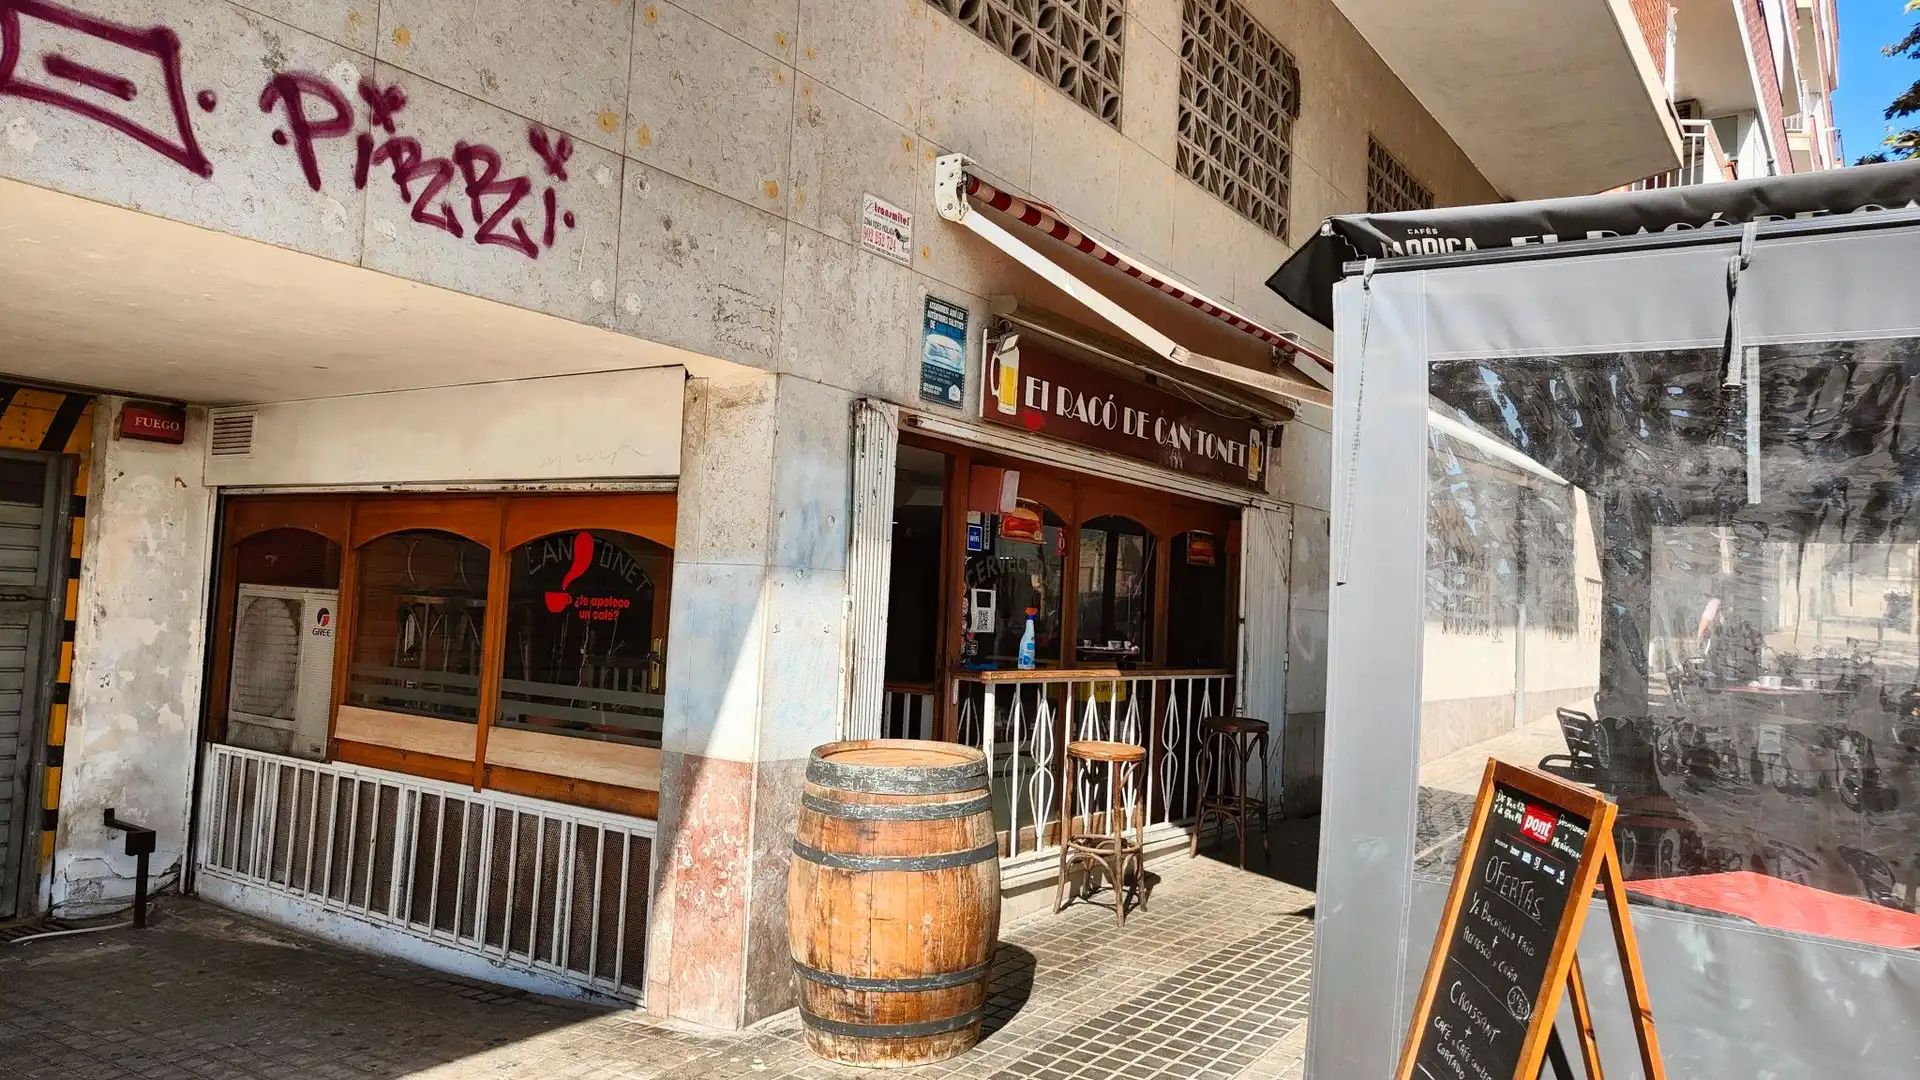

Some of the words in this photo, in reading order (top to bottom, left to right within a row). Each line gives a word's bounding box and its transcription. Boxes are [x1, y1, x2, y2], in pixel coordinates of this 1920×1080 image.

[135, 416, 180, 431] FUEGO
[1056, 385, 1118, 430] RACÓ
[1123, 407, 1150, 440] DE
[1154, 416, 1192, 452] CAN
[1196, 429, 1248, 468] TONET
[590, 595, 631, 609] apetece
[579, 609, 591, 620] un
[592, 608, 620, 621] café?
[312, 627, 332, 637] GREE
[1523, 815, 1552, 837] pont
[1485, 856, 1544, 920] OFERTAS
[1450, 980, 1501, 1045] CROISSANT
[1437, 1042, 1465, 1079] CORTADO
